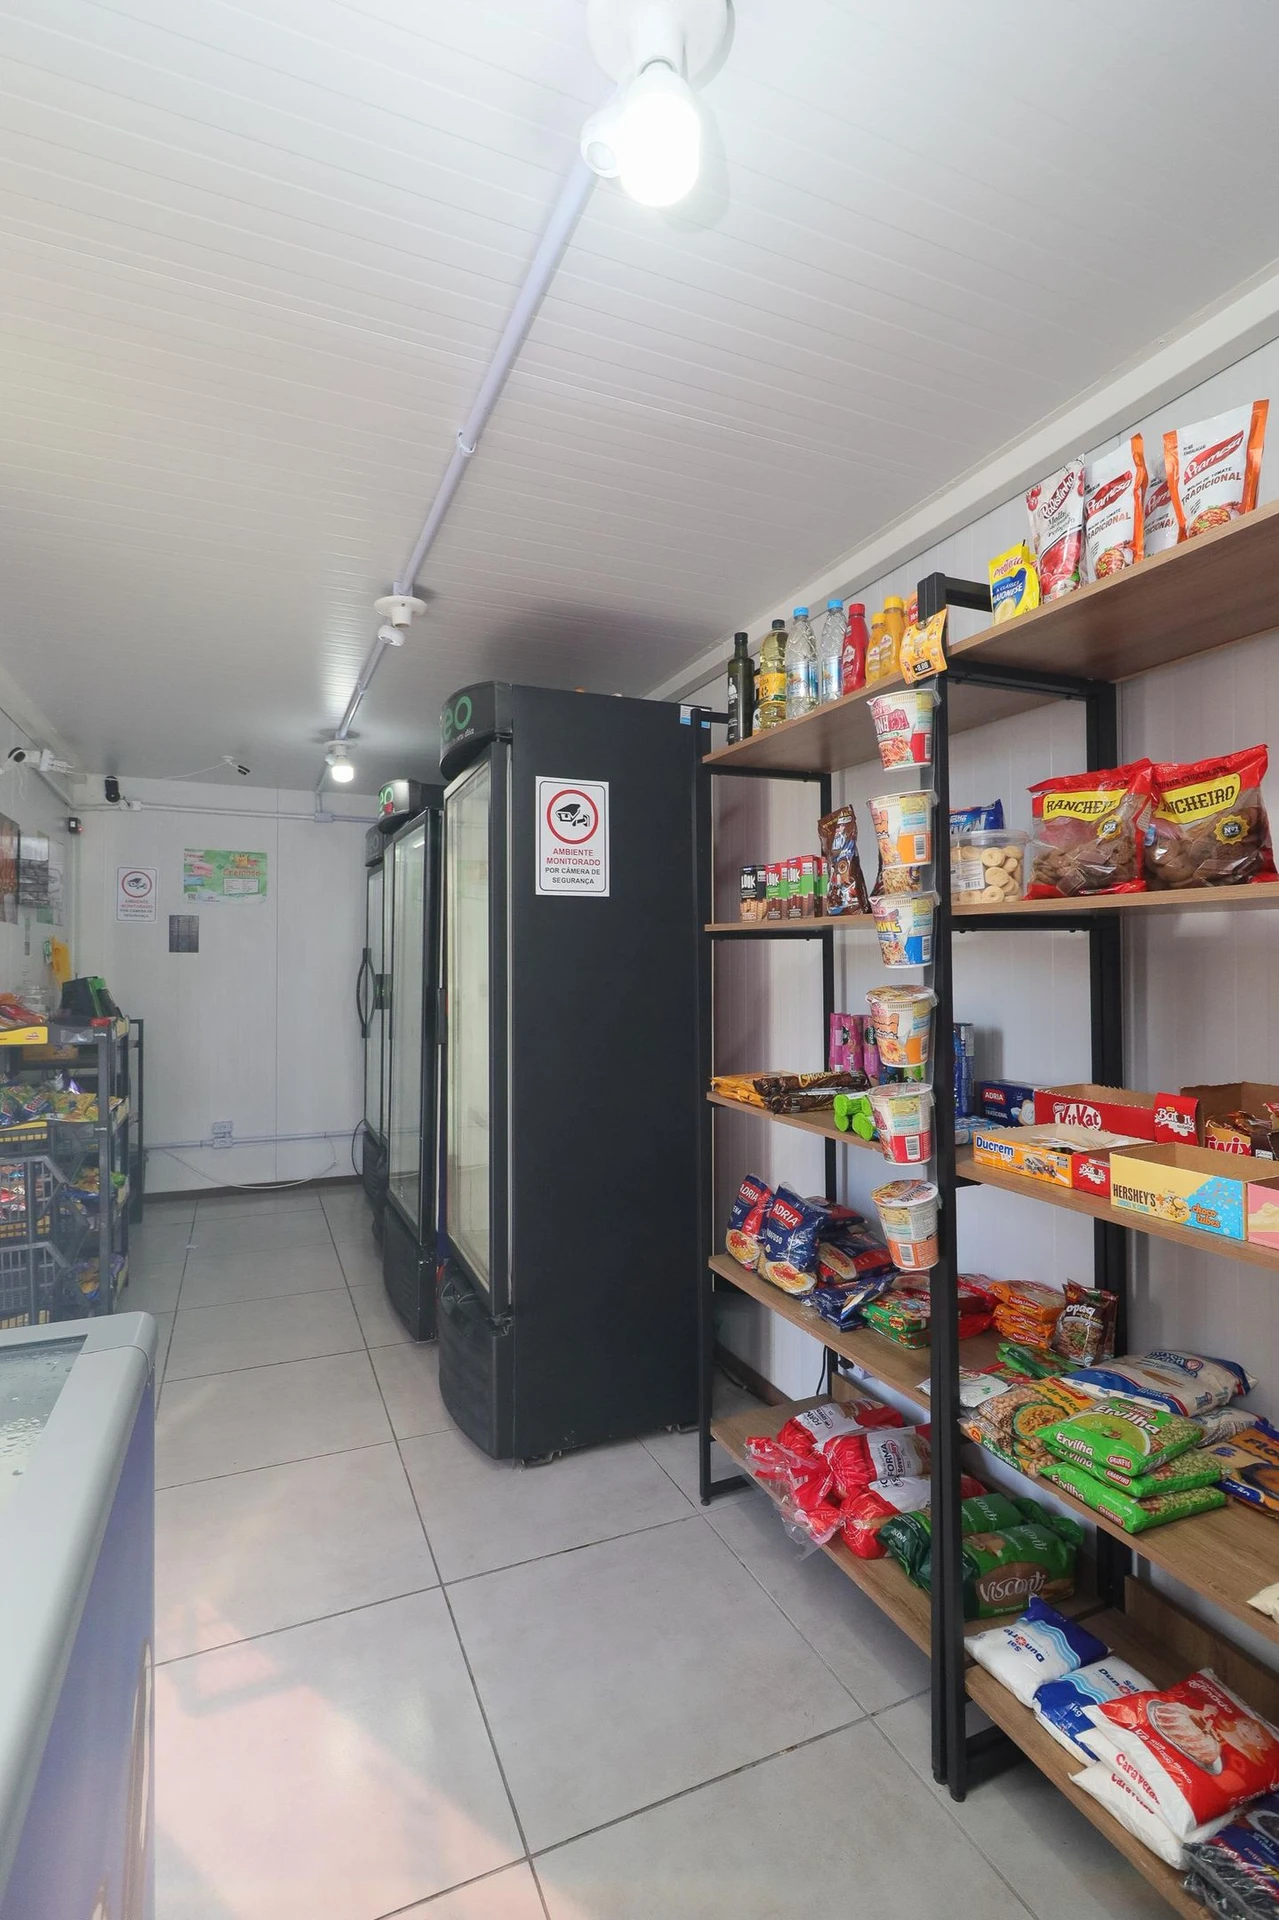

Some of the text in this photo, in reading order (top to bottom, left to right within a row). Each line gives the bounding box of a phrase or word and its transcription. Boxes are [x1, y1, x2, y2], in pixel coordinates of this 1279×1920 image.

[1182, 472, 1241, 505] TRADICIONAL
[1087, 512, 1131, 539] RADICIONAL
[1162, 786, 1235, 815] NCHEIRO
[546, 857, 601, 866] MONITORADO
[552, 848, 594, 857] AMBIENTE
[552, 877, 595, 885] SEGURANÇA
[561, 867, 590, 875] CÂMERA
[984, 1091, 1004, 1101] ADRIA
[1060, 1104, 1099, 1129] KitKat
[976, 1136, 1014, 1157] Ducrem
[740, 1183, 759, 1202] ADRIA
[1113, 1183, 1156, 1207] HERSHEY'S
[772, 1203, 799, 1226] ADRIA
[1094, 1404, 1160, 1435] Ervilha
[1056, 1433, 1094, 1456] Ervilha
[881, 1442, 895, 1477] FORMA
[1051, 1474, 1085, 1502] Ervilha
[980, 1571, 1046, 1603] Visconti
[1007, 1640, 1023, 1653] Sal
[1123, 1680, 1139, 1692] Sal
